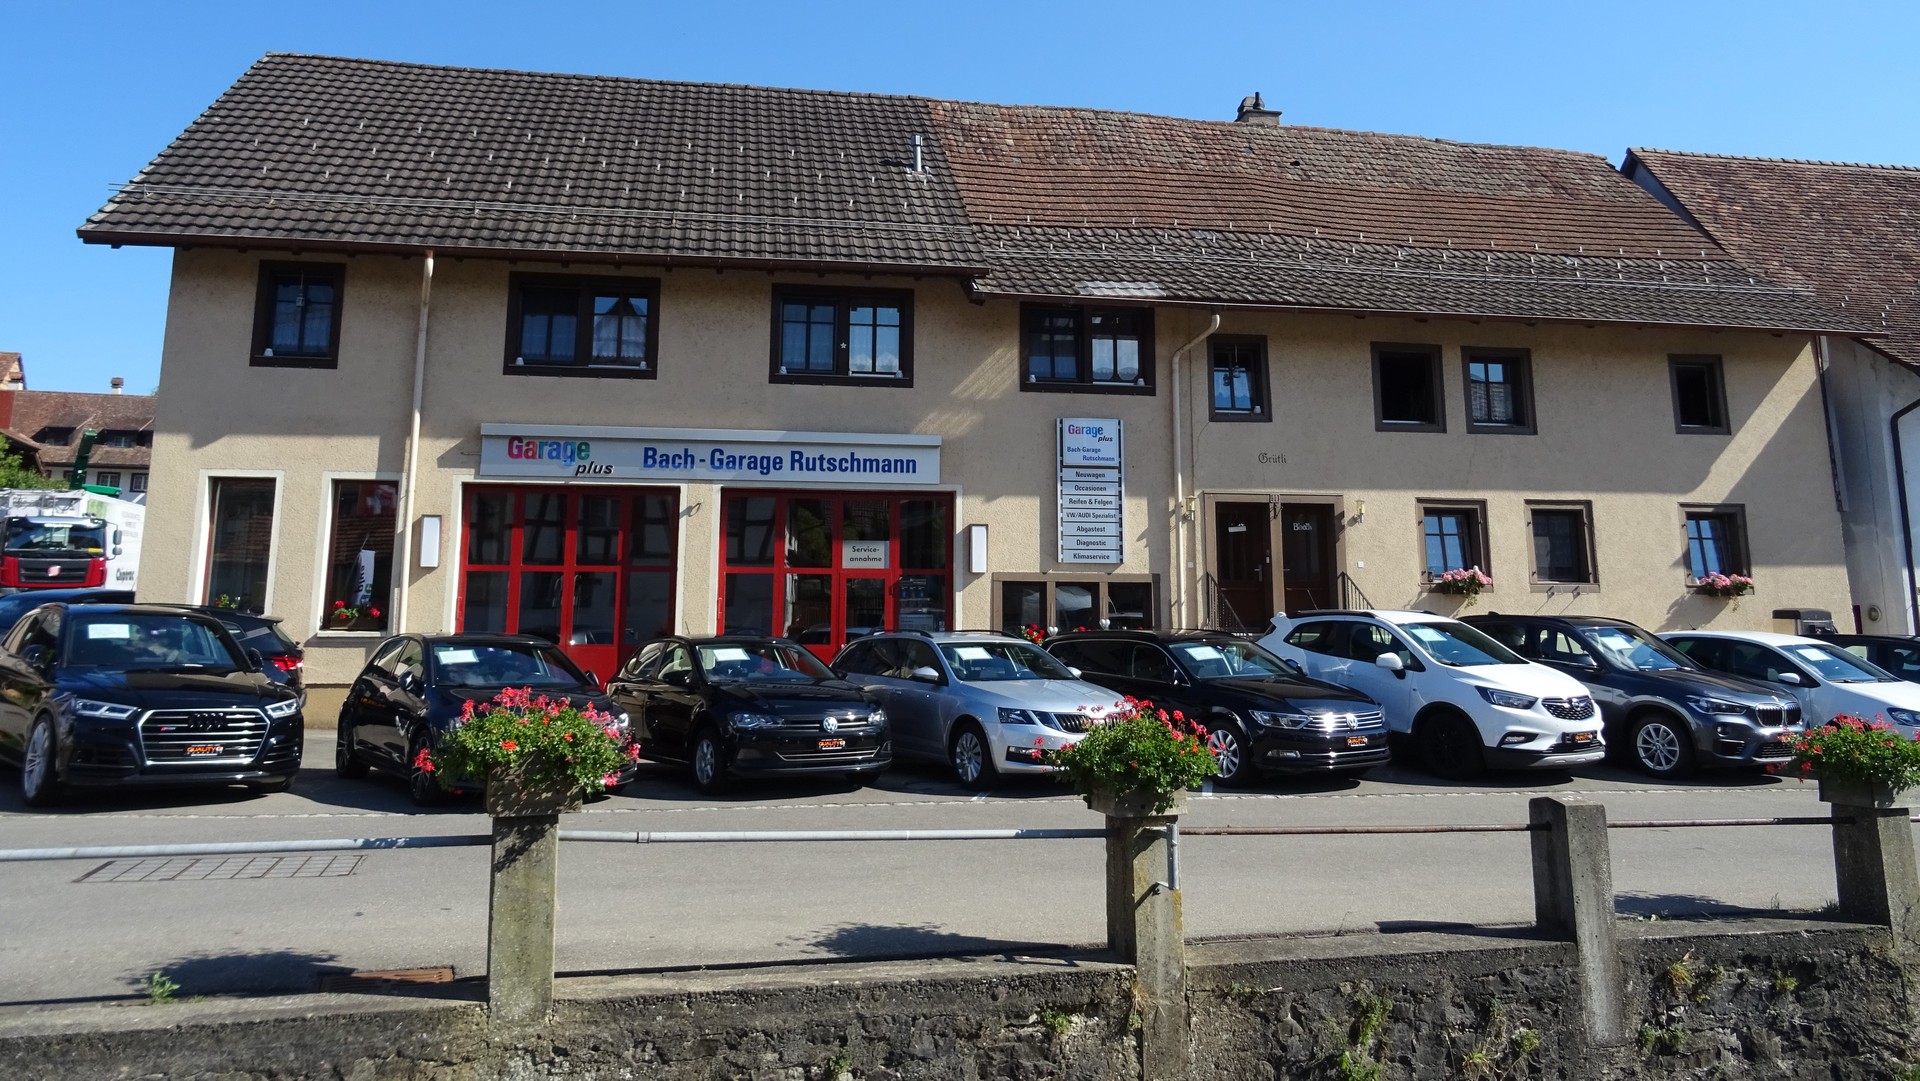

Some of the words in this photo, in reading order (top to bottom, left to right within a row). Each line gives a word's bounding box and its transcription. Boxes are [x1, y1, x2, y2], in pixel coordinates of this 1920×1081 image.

[1067, 424, 1104, 438] Garage
[1097, 435, 1113, 443] plus
[507, 435, 591, 467] Garage
[1066, 446, 1102, 454] Bach-Garage
[790, 450, 917, 474] Rutschmann
[1082, 454, 1116, 462] Rutschmann
[575, 460, 614, 477] plus
[1075, 471, 1106, 479] Neuwagen
[1074, 484, 1107, 492] Occasionen
[1094, 499, 1113, 507] Felgen
[1092, 512, 1116, 520] Spezialist
[1076, 525, 1106, 534] Abgastest
[1076, 539, 1107, 547] Diagnostic
[852, 545, 880, 553] Service-
